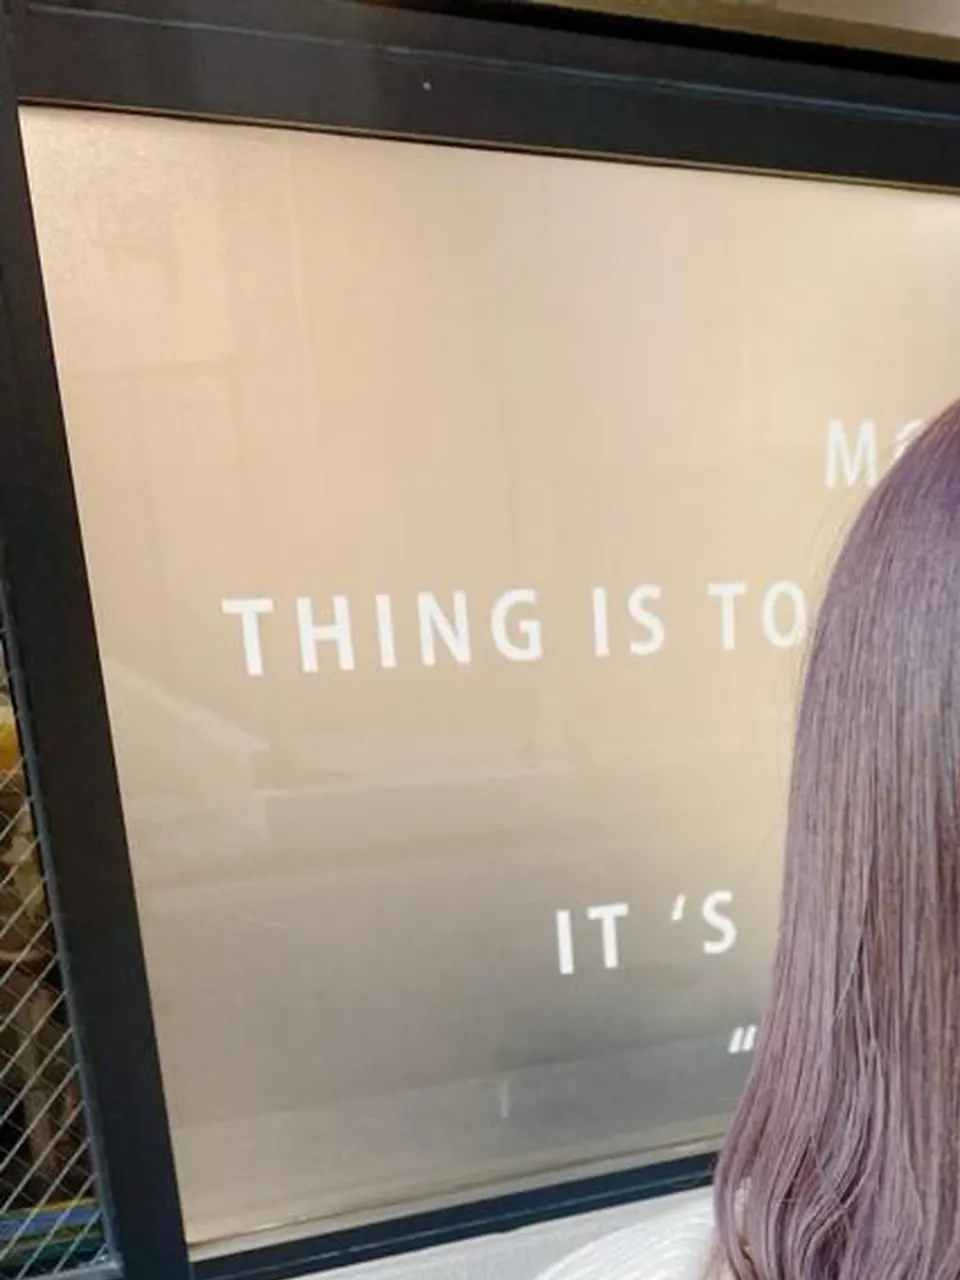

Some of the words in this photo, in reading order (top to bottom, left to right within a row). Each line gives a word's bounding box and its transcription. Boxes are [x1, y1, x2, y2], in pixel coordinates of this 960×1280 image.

[221, 590, 542, 676] THING
[592, 584, 666, 658] IS
[707, 580, 808, 650] TO
